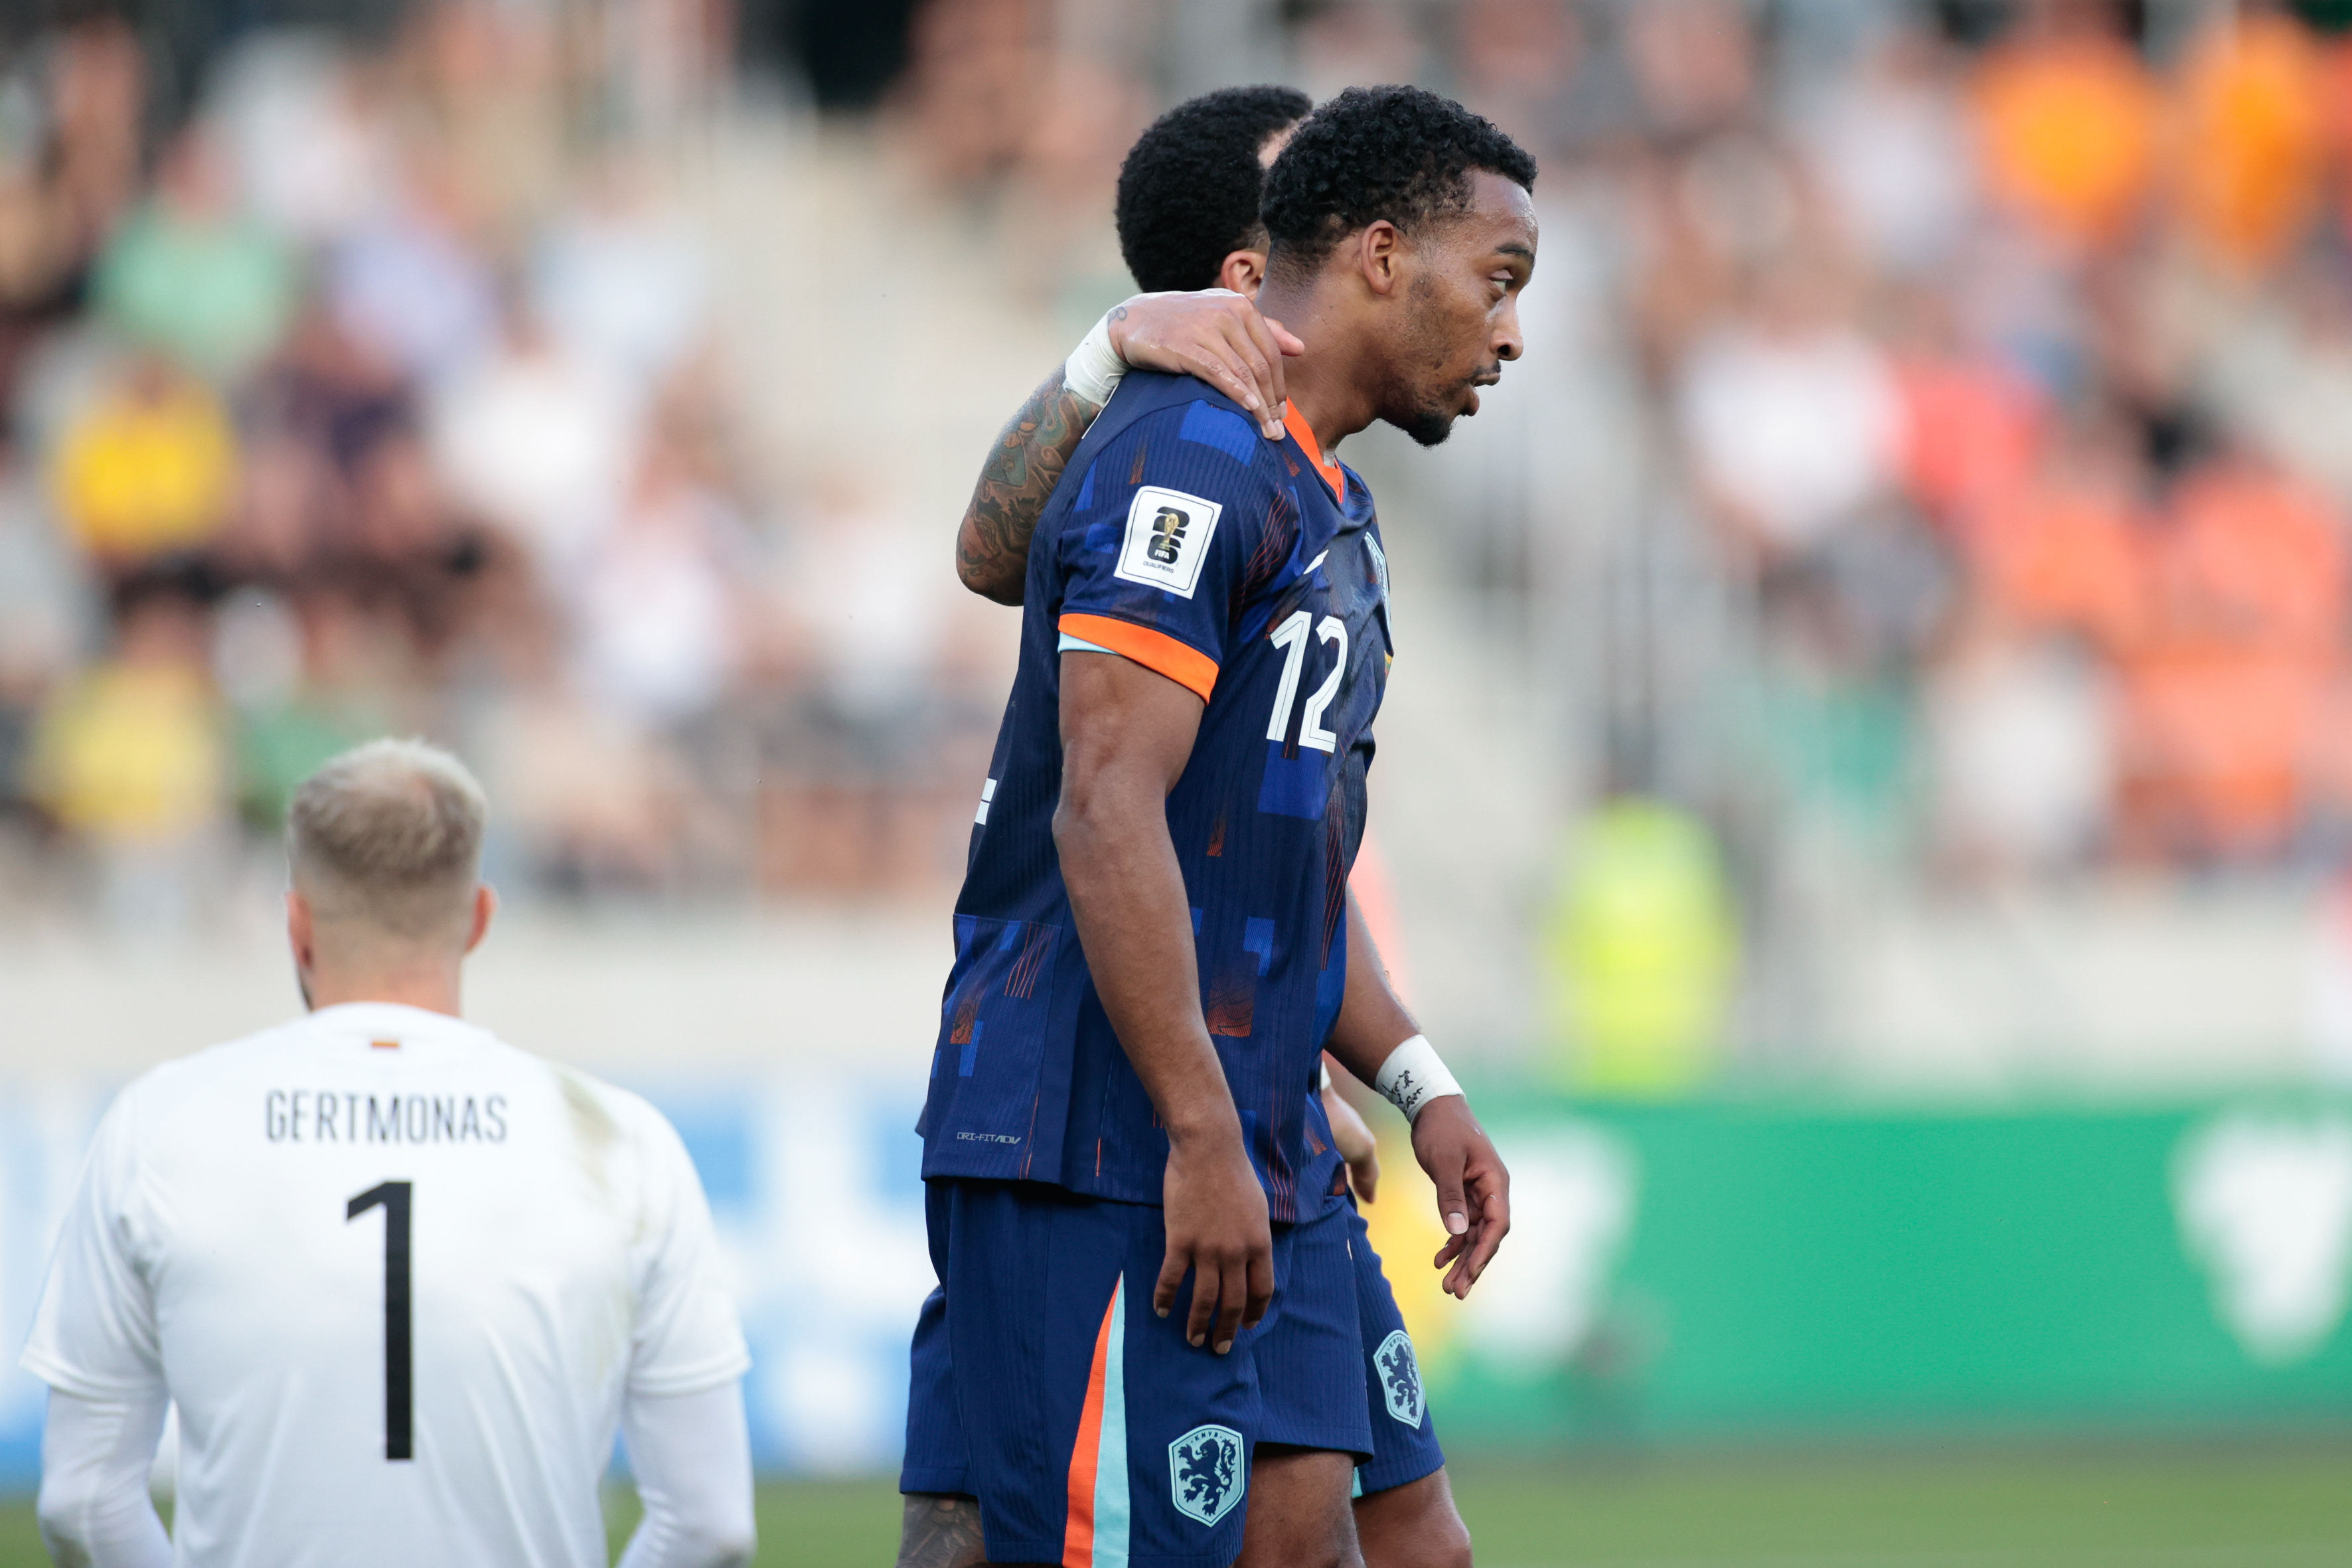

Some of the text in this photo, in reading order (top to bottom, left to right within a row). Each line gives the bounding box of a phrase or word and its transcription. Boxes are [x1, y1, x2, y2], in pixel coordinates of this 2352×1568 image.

[1143, 561, 1174, 574] QUALIFIERS
[1154, 549, 1170, 560] FIFA
[1266, 610, 1348, 753] 12
[267, 1091, 507, 1144] GERTMONAS
[347, 1181, 413, 1460] 1
[1194, 1431, 1219, 1441] KNVB
